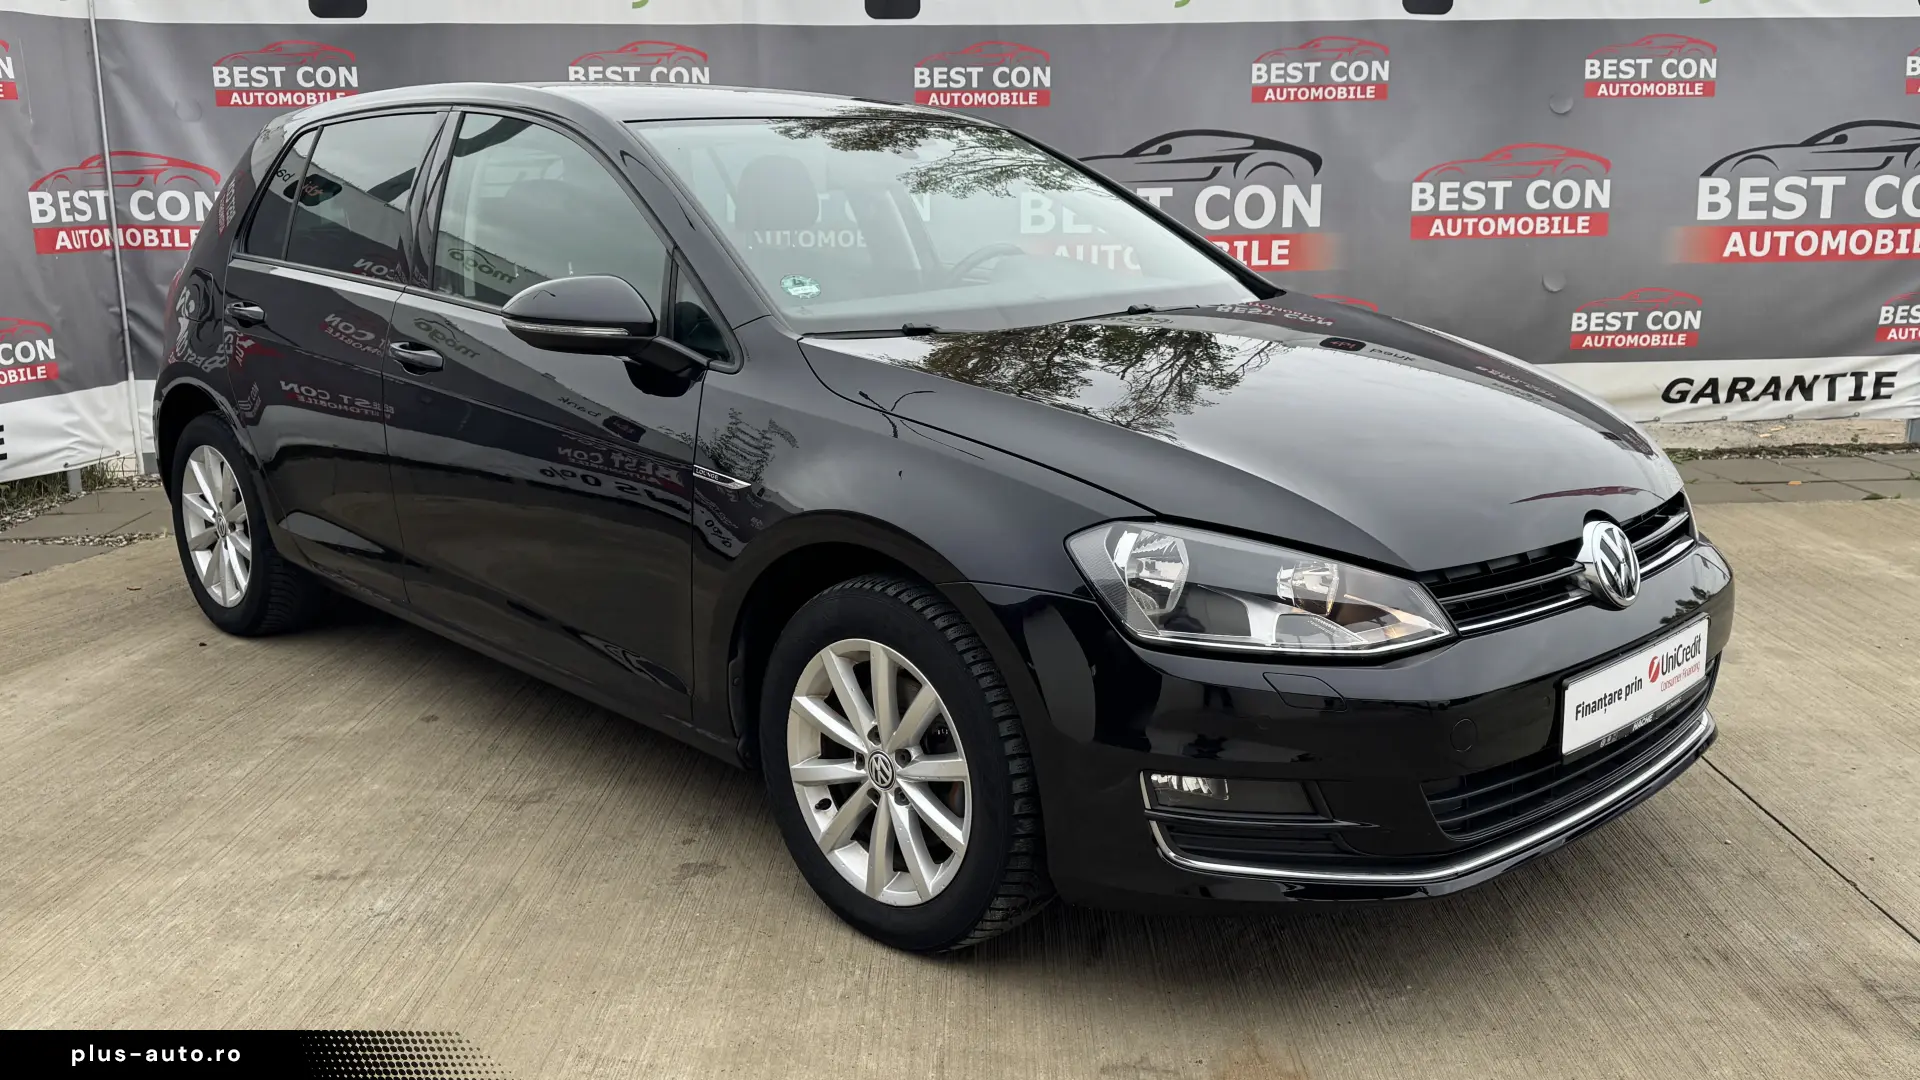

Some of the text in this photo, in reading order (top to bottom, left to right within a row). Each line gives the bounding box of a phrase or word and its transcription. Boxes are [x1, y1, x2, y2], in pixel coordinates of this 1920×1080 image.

[213, 66, 359, 87] BEST CON
[914, 66, 1051, 88] BEST CON
[1251, 60, 1390, 84] BEST CON
[1584, 58, 1717, 79] BEST CON
[928, 92, 1038, 105] AUTOMOBILE
[1264, 86, 1376, 101] AUTOMOBILE
[1597, 83, 1704, 96] AUTOMOBILE
[1411, 178, 1611, 212] BEST CON
[1697, 176, 1847, 221] BEST
[28, 189, 110, 224] BEST
[129, 189, 220, 222] CON
[1194, 184, 1322, 230] CON
[1429, 216, 1590, 237] AUTOMOBILE
[1570, 310, 1702, 332] BEST CON
[1582, 333, 1687, 347] AUTOMOBILE
[0, 338, 56, 366] CON
[1661, 371, 1898, 404] GARANTIE
[695, 468, 719, 481] LOUNGE
[1661, 633, 1702, 676] UniCredit
[1625, 676, 1643, 702] prin
